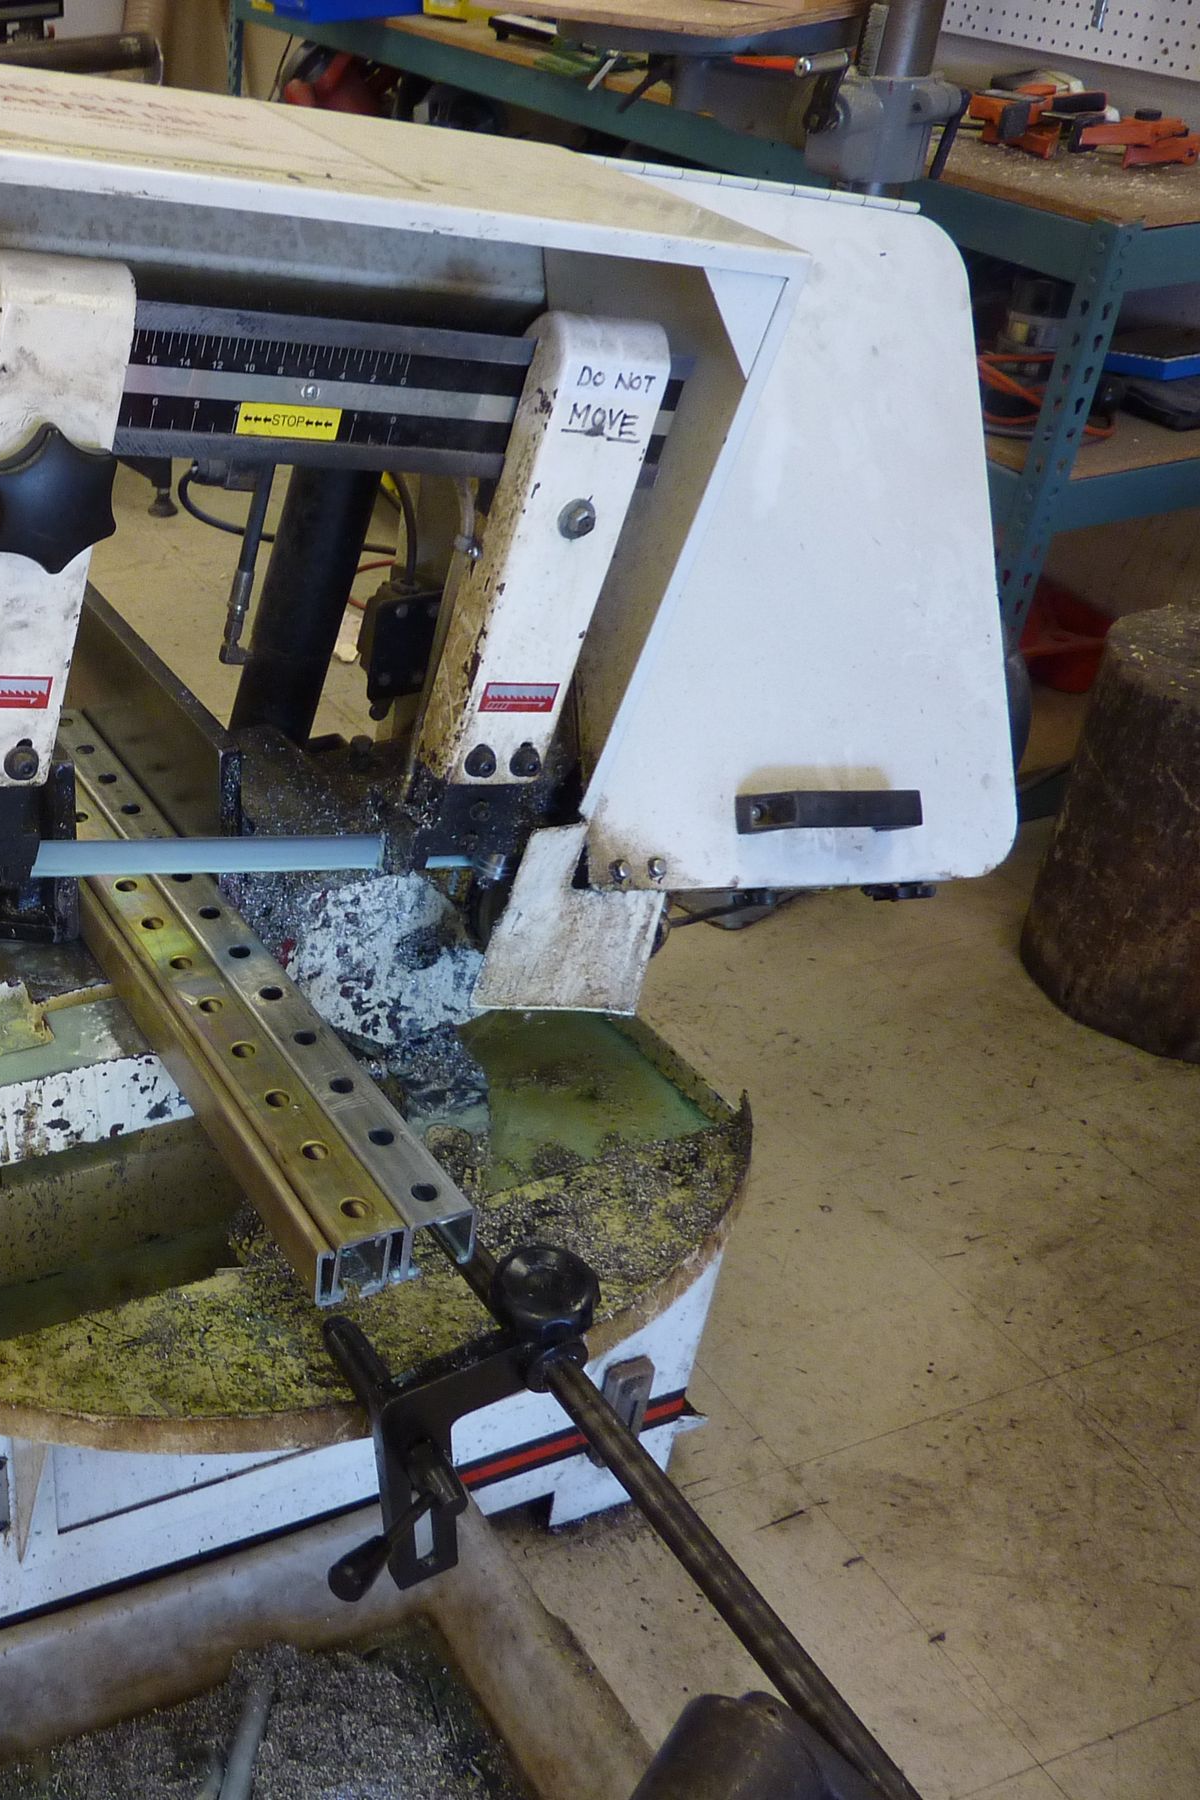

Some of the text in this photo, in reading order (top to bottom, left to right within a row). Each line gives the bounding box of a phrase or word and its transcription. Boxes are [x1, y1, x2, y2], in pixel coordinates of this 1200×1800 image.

[146, 355, 407, 385] 16 14 12 10 8 6 4 2 0
[576, 365, 656, 393] DO NOT
[152, 397, 159, 406] 6
[193, 400, 200, 409] 5
[271, 414, 306, 428] STOP
[390, 415, 397, 424] 0
[568, 401, 640, 438] MOVE
